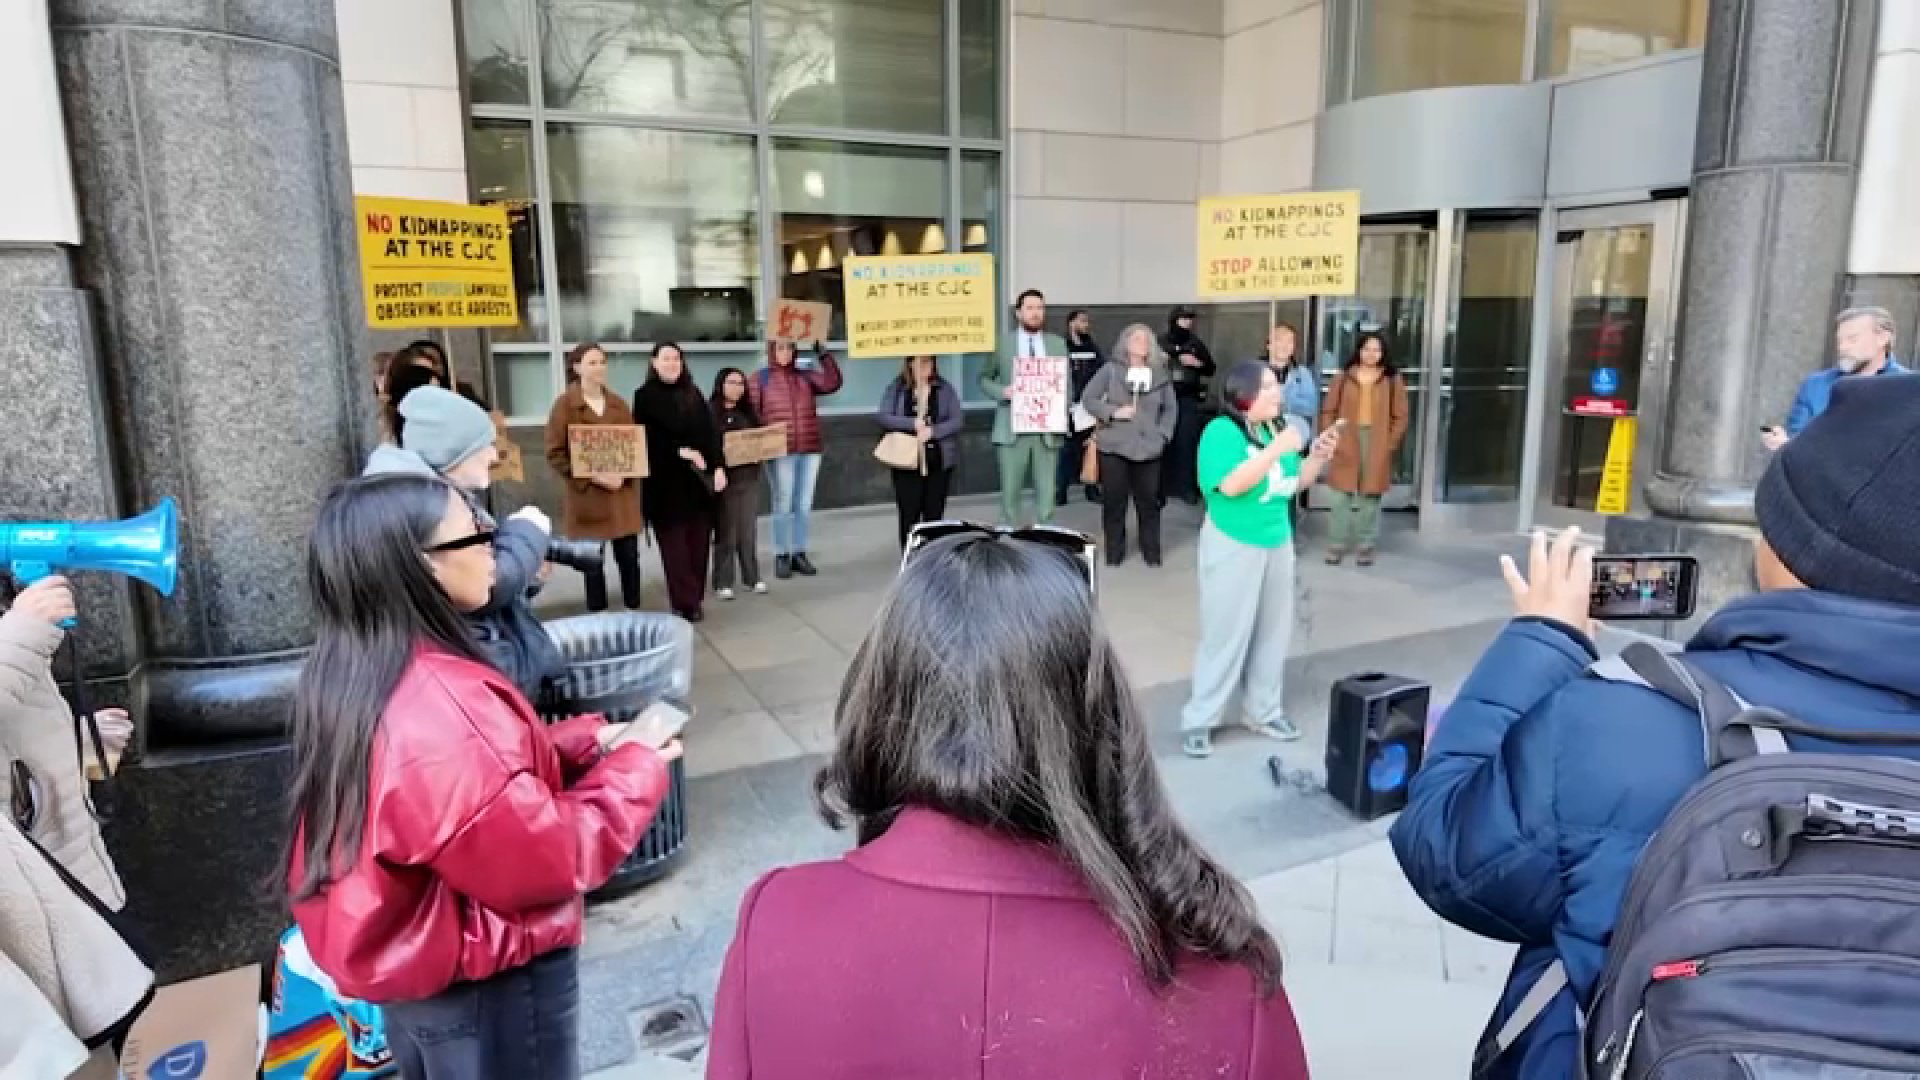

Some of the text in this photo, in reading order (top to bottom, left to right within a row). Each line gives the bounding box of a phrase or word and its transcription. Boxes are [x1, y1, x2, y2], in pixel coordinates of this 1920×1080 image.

[1213, 202, 1344, 224] NO KIDNAPPINGS
[366, 213, 502, 240] NO KIDNAPPINGS
[1224, 222, 1332, 240] AT THE CJC
[384, 238, 497, 260] AT THE CJC
[1209, 255, 1344, 275] STOP ALLOWING
[374, 282, 422, 298] PROTECT
[866, 280, 972, 298] AT THE CJC
[1252, 275, 1279, 288] THE
[1282, 273, 1343, 287] BUILDING
[376, 301, 513, 320] OBSERVING ICE ARRESTS
[164, 1051, 196, 1077] D
